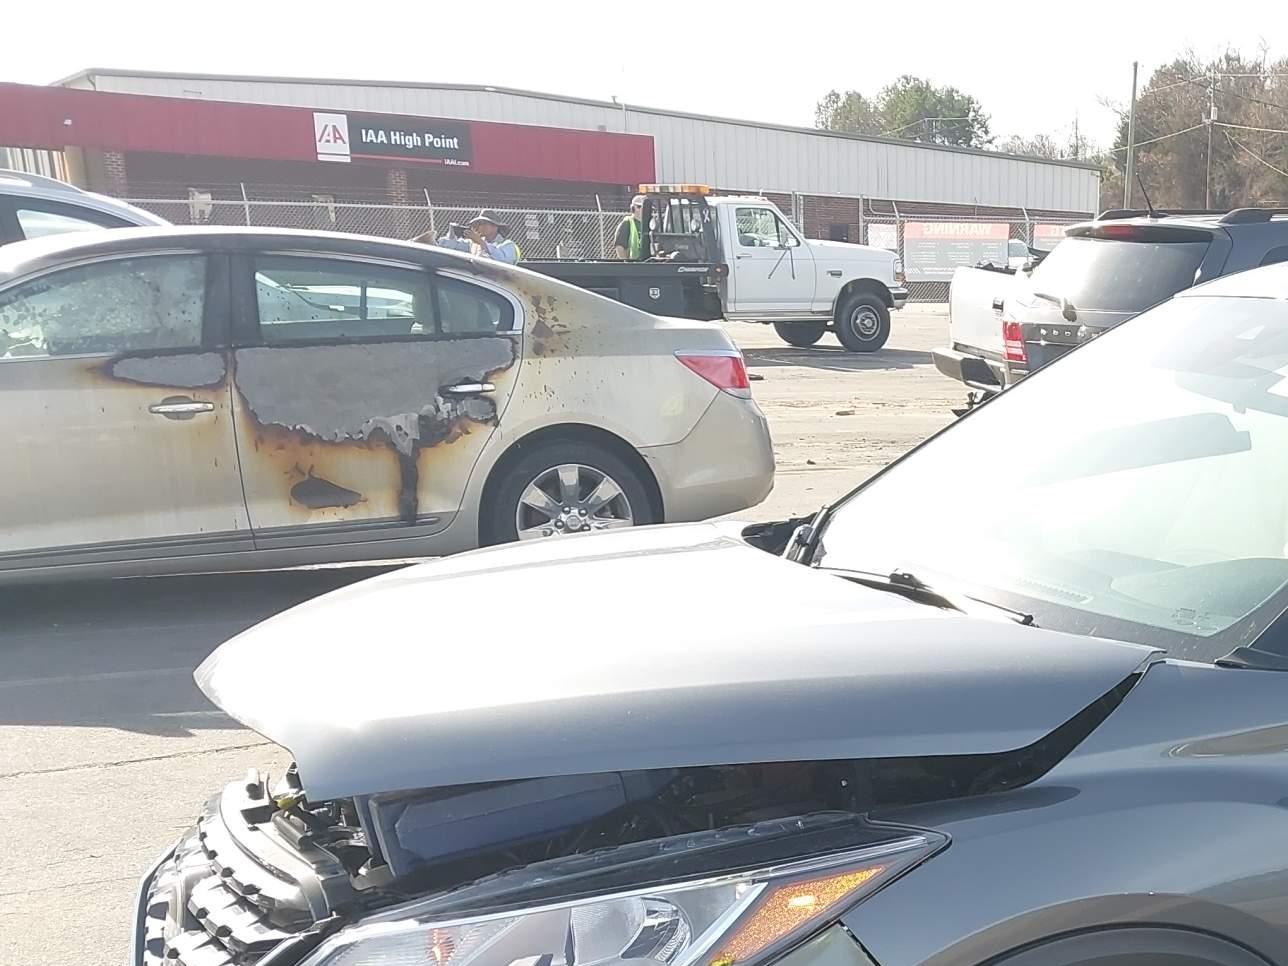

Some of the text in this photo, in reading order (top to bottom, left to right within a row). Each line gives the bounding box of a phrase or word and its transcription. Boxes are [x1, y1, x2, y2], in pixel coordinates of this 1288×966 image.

[361, 128, 459, 149] IAA High Point
